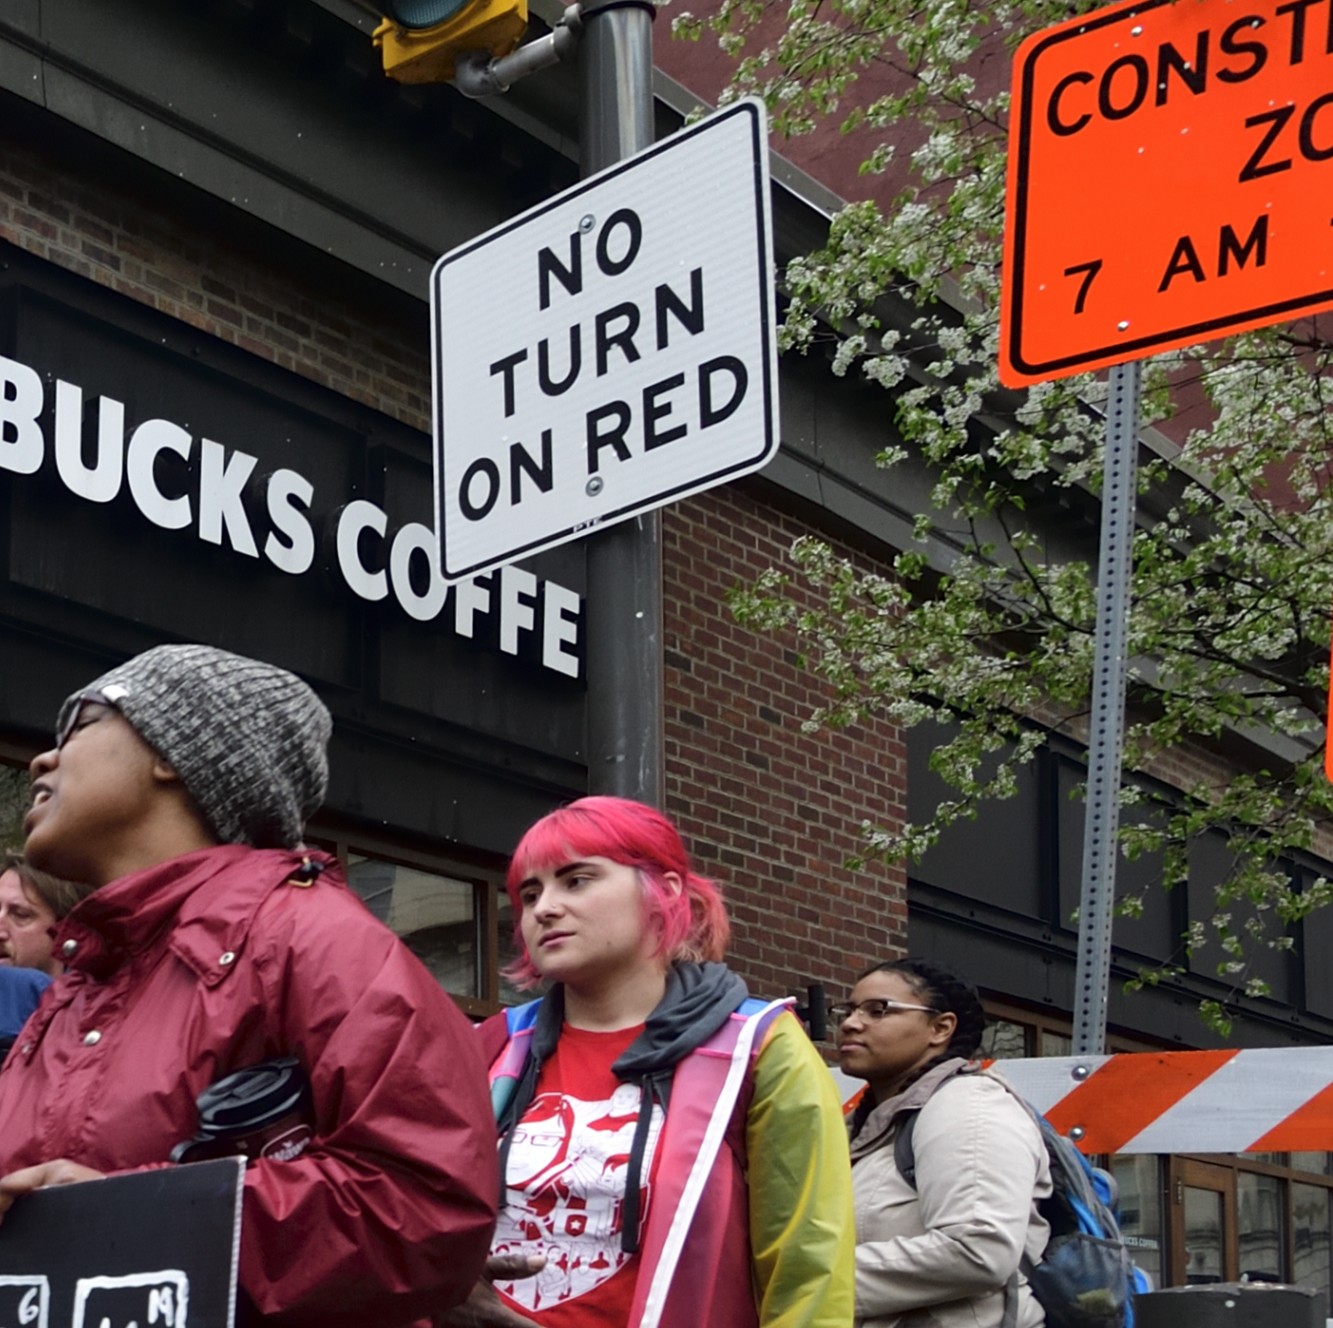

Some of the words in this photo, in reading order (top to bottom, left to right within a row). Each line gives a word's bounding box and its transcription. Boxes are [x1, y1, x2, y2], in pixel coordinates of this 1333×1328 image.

[1047, 0, 1333, 137] CONST
[538, 208, 642, 311] NO
[1064, 259, 1103, 314] 7
[1157, 214, 1269, 293] AM
[490, 267, 704, 418] TURN
[459, 428, 553, 521] ON
[586, 355, 748, 475] RED
[18, 1287, 40, 1325] 6
